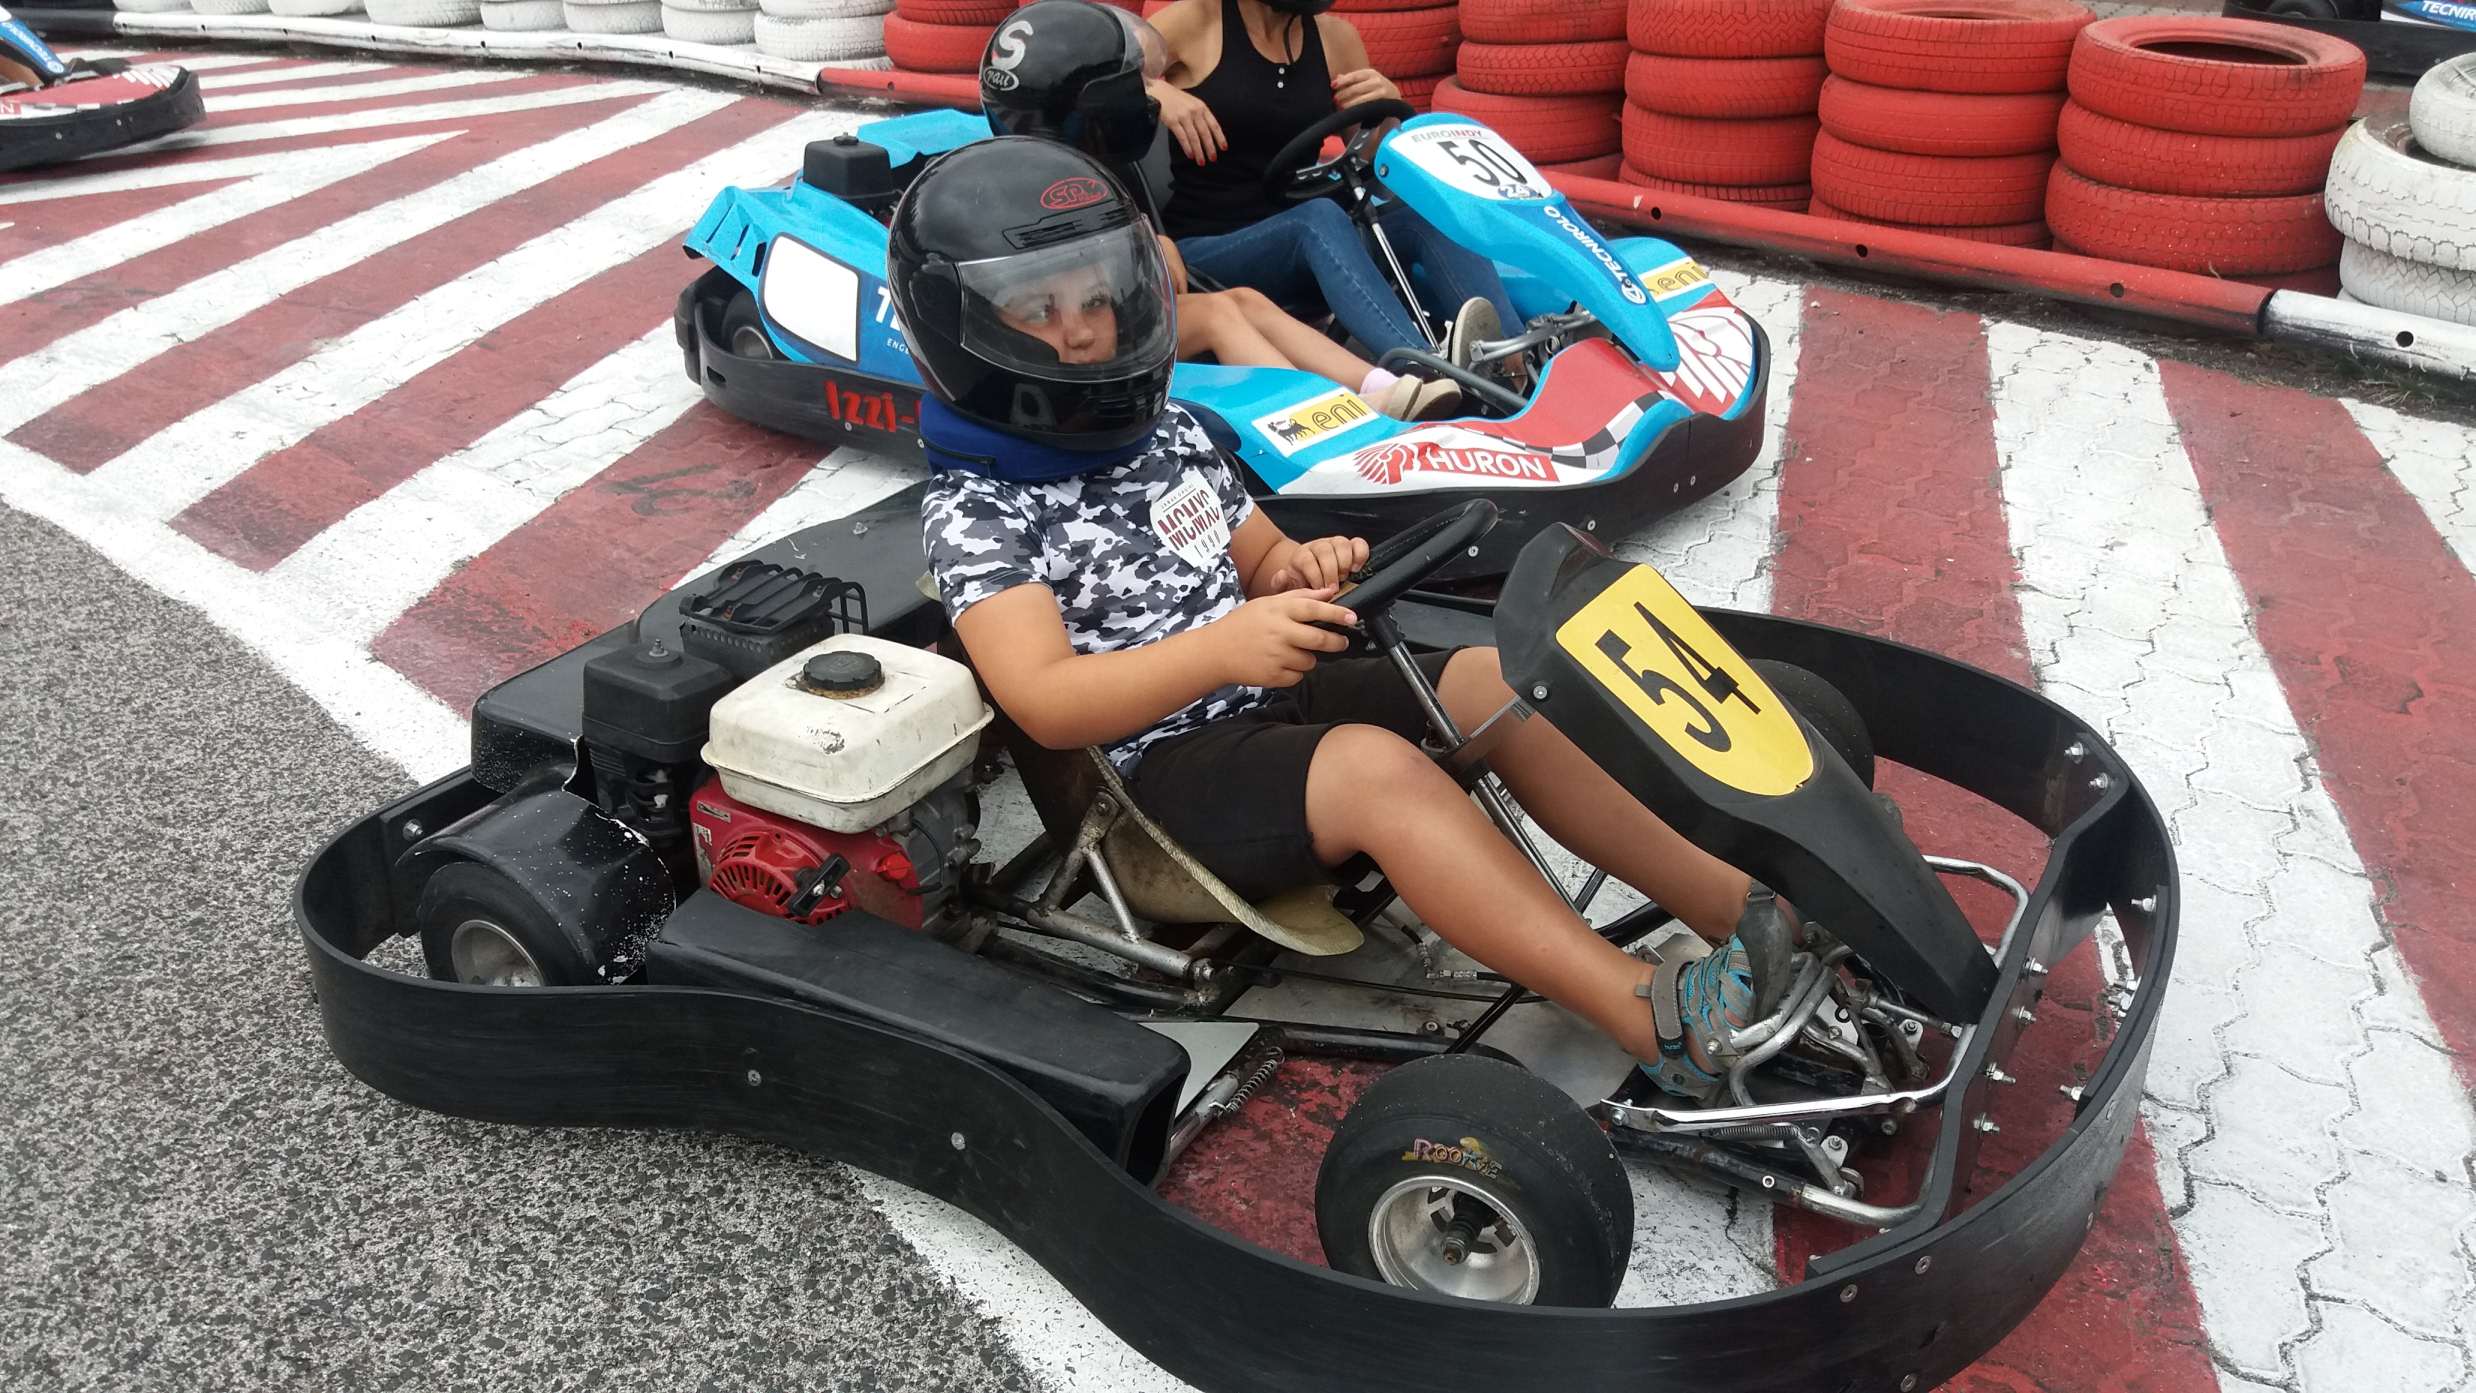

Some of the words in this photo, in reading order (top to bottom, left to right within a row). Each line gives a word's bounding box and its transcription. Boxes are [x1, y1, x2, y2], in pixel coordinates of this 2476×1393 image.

[1411, 129, 1483, 142] EUROINDY
[1437, 139, 1527, 187] 50
[1544, 205, 1629, 282] TECNIROLO
[1311, 393, 1369, 430] eni
[1428, 447, 1548, 479] HURON
[1594, 601, 1762, 753] 54
